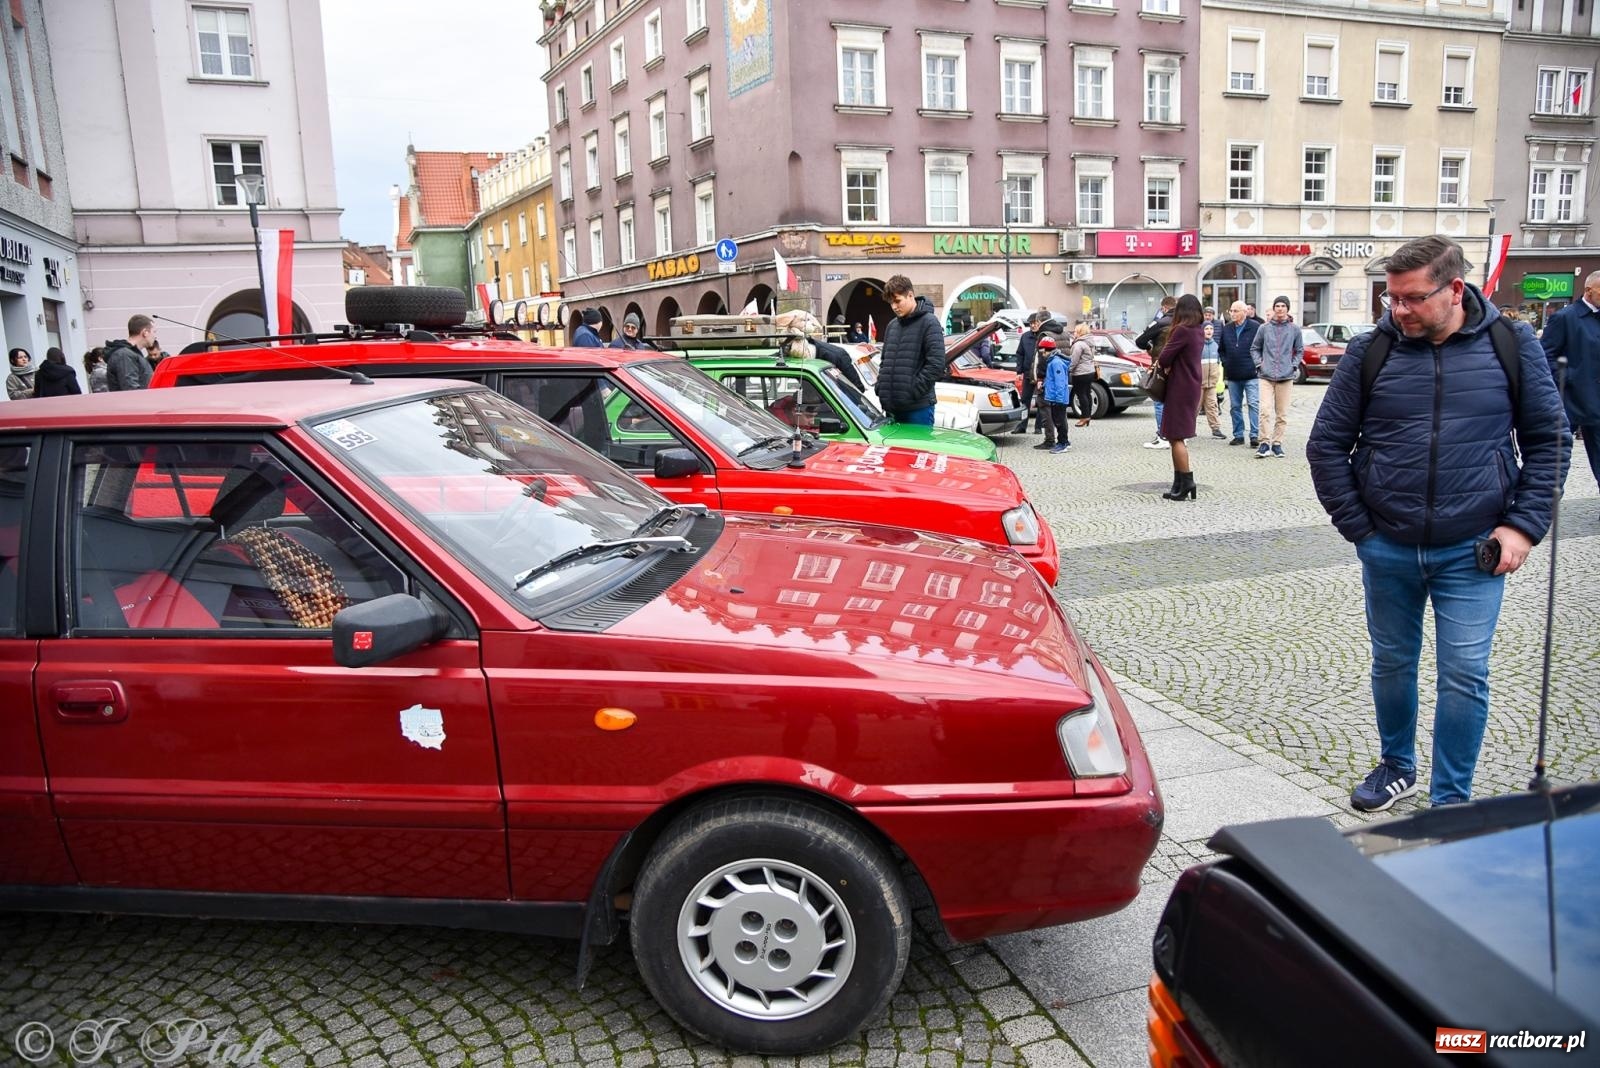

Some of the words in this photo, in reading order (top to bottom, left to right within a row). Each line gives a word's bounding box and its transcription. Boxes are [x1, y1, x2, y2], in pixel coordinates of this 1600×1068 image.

[0, 236, 33, 266] UBILER
[933, 234, 1031, 255] KANTOR
[1181, 234, 1193, 252] T
[1240, 244, 1311, 256] RESTAURACJA
[1332, 242, 1376, 258] SHIRO
[960, 291, 997, 300] KANTOR
[336, 430, 375, 448] 593
